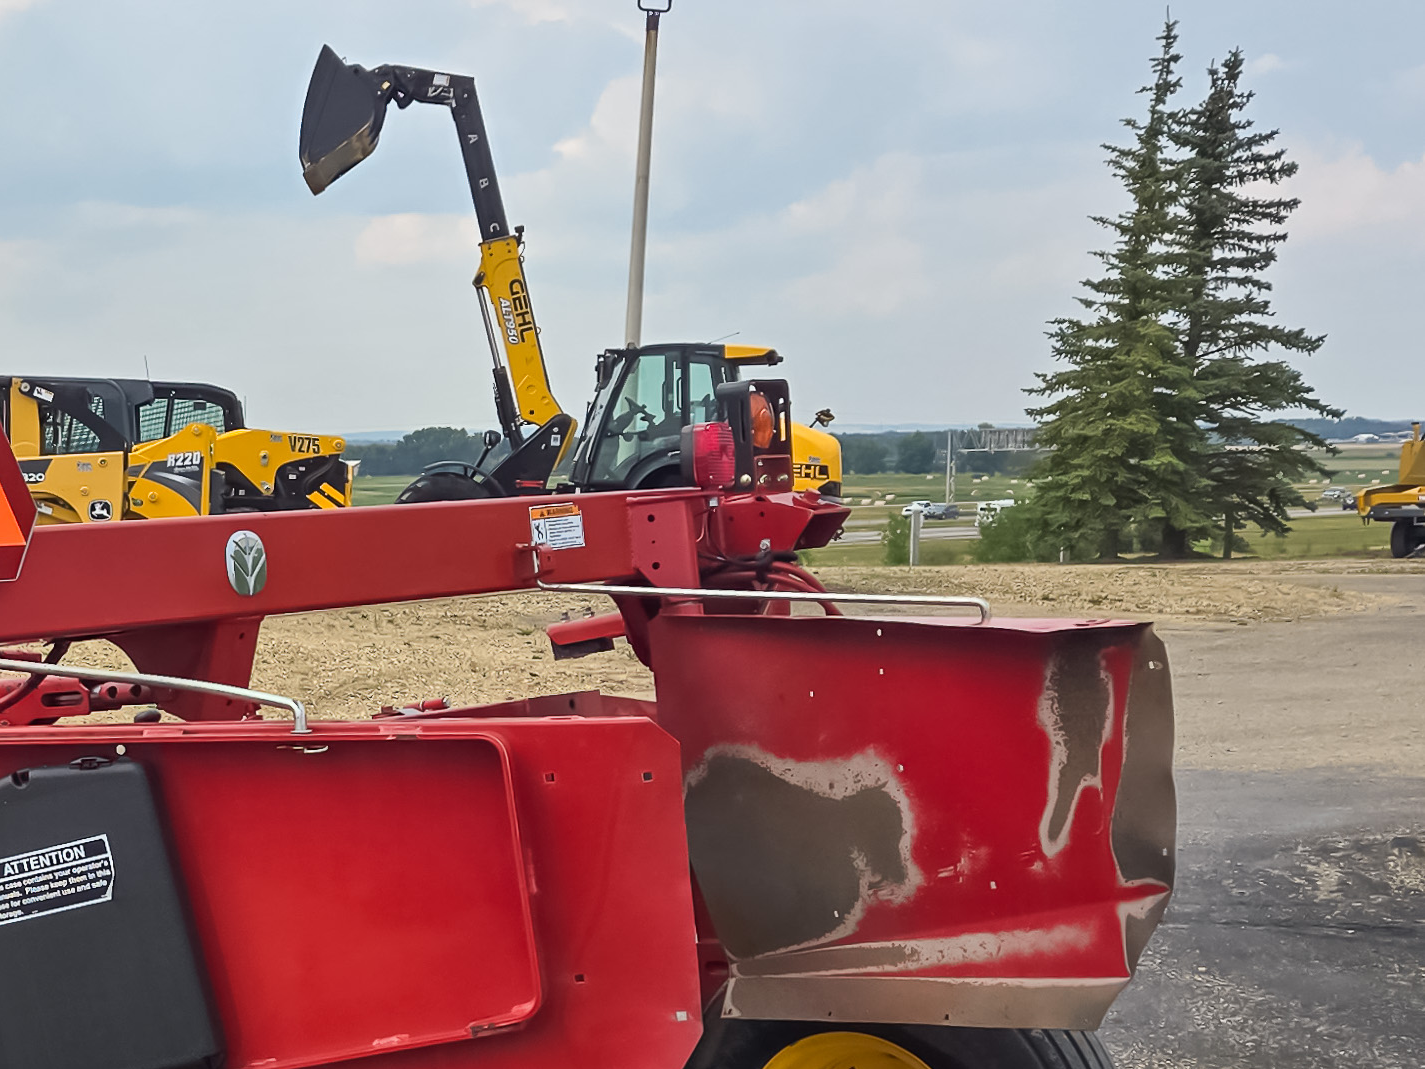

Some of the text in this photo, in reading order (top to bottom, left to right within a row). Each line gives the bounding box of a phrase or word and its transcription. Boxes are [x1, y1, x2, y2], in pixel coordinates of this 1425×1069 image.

[498, 297, 520, 344] ALT950
[508, 278, 533, 343] GEHL
[166, 451, 201, 467] R220
[287, 435, 321, 454] V275
[793, 464, 828, 479] EHL
[3, 845, 86, 876] ATTENTION
[5, 881, 23, 890] case
[23, 872, 54, 887] contains
[54, 869, 71, 880] your
[72, 860, 109, 874] operator's
[10, 899, 21, 908] for
[22, 889, 62, 906] convenient
[62, 886, 76, 896] use
[76, 882, 91, 893] and
[91, 879, 108, 889] safe
[25, 883, 50, 895] Please
[50, 879, 68, 889] keep
[69, 874, 88, 884] them
[88, 872, 96, 880] in
[96, 868, 112, 878] this
